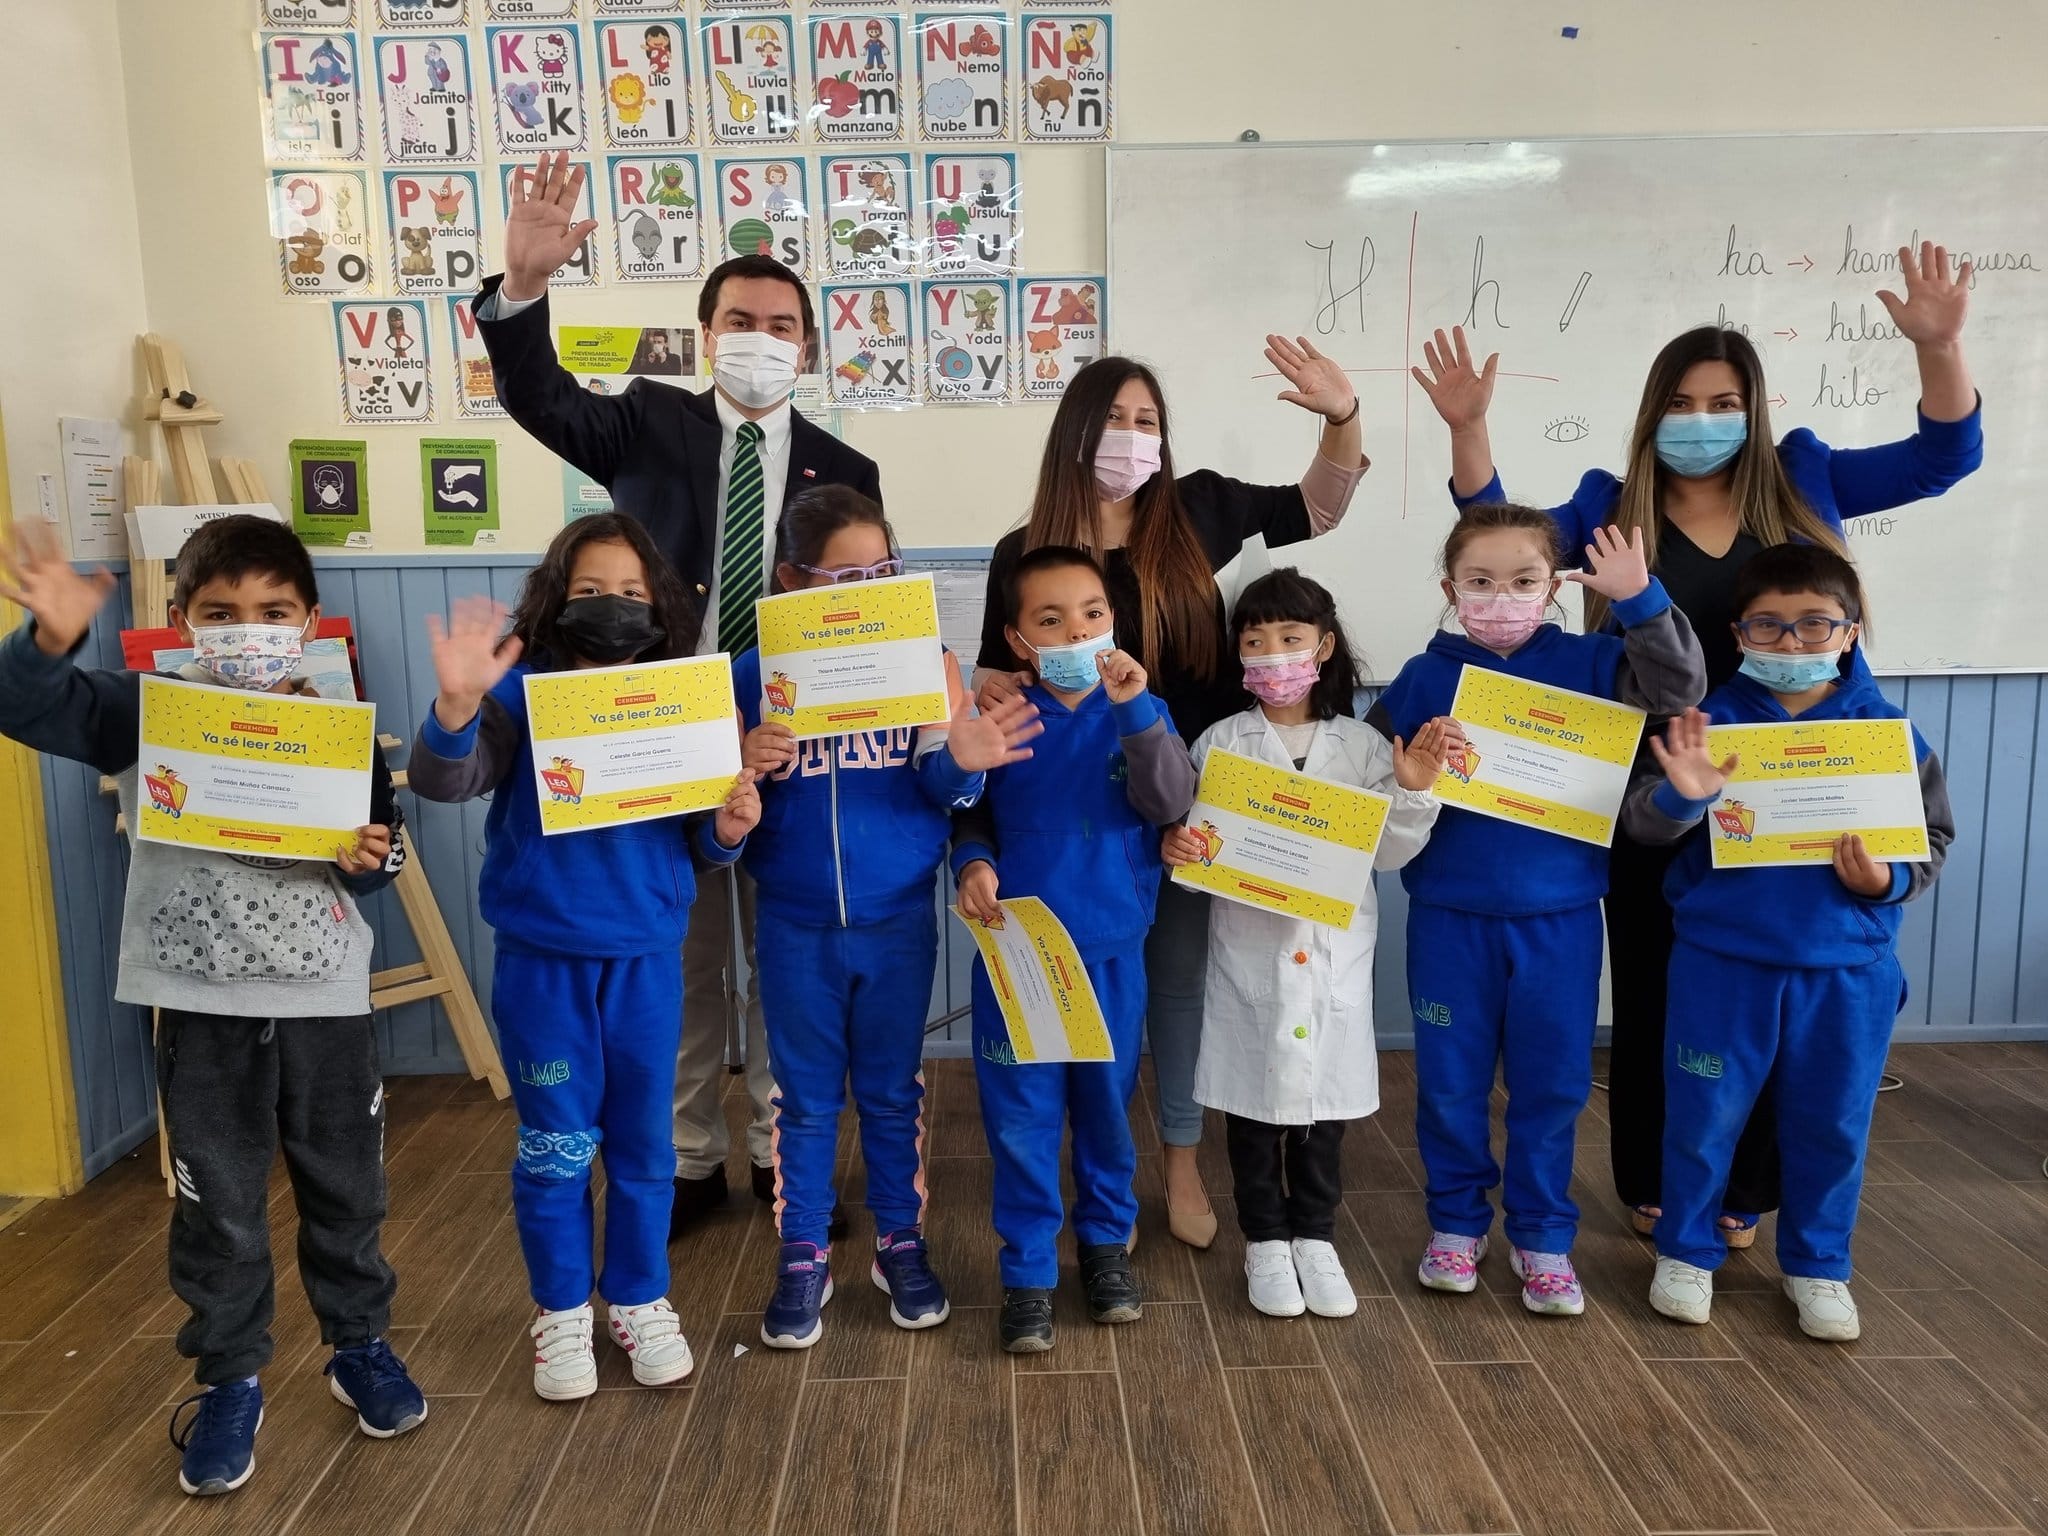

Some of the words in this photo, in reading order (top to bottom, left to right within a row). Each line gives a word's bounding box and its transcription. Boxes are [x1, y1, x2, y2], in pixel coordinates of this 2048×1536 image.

[273, 6, 317, 21] abeja
[390, 8, 433, 21] barco
[497, 2, 533, 13] casa
[607, 28, 628, 69] L
[817, 22, 857, 59] M
[926, 21, 957, 62] N
[1032, 21, 1061, 69] Ñ
[274, 39, 305, 82] I
[388, 44, 406, 83] J
[499, 34, 529, 75] K
[854, 69, 894, 83] Mario
[956, 60, 1001, 74] Nemo
[1066, 66, 1105, 82] Ñoño
[542, 80, 571, 97] Kitty
[648, 73, 671, 87] Lilo
[747, 74, 788, 88] Lluvia
[316, 90, 350, 106] Igor
[413, 91, 466, 105] Jaimito
[859, 86, 896, 116] m
[1078, 86, 1101, 128] ñ
[549, 98, 578, 136] k
[974, 96, 1000, 127] n
[330, 109, 343, 149] i
[445, 107, 458, 156] j
[617, 124, 649, 140] león
[722, 122, 756, 137] llave
[827, 120, 894, 134] manzana
[931, 119, 967, 133] nube
[1044, 119, 1062, 133] ñu
[288, 139, 313, 153] isla
[506, 130, 548, 144] koala
[399, 139, 437, 158] jirafa
[620, 166, 645, 205] R
[729, 168, 752, 206] S
[833, 164, 853, 202] T
[936, 165, 961, 203] U
[286, 177, 323, 217] O
[397, 180, 421, 218] P
[659, 206, 694, 221] René
[861, 210, 907, 222] Tarzan
[968, 203, 1009, 219] Úrsula
[332, 231, 362, 247] Olaf
[431, 225, 476, 239] Patricio
[672, 235, 687, 263] r
[782, 237, 800, 266] s
[977, 234, 1001, 262] u
[1717, 223, 1774, 276] ha
[628, 258, 665, 272] ratón
[836, 259, 886, 274] tortuga
[941, 260, 966, 270] uva
[1836, 224, 2042, 291] hambrguesa
[337, 253, 366, 283] o
[447, 249, 475, 288] p
[295, 275, 321, 287] oso
[405, 276, 444, 290] perro
[1306, 235, 1376, 335] H
[1462, 233, 1510, 330] h
[831, 293, 863, 331] X
[930, 288, 957, 326] Y
[1030, 286, 1053, 324] Z
[346, 311, 378, 349] V
[1064, 328, 1095, 340] Zeus
[858, 334, 906, 348] Xóchitl
[965, 333, 1002, 346] Yoda
[375, 356, 424, 371] Violeta
[881, 358, 908, 386] x
[977, 354, 1003, 391] y
[840, 386, 896, 400] xilófono
[936, 381, 972, 395] yoyo
[1031, 380, 1065, 390] zorro
[1812, 363, 1889, 409] hilo
[397, 381, 423, 408] v
[470, 397, 501, 409] waff
[355, 404, 393, 415] vaca
[824, 613, 859, 623] CEREMONIA
[801, 630, 816, 640] Ya
[818, 627, 831, 639] sé
[834, 625, 855, 637] leer
[859, 621, 886, 634] 2021
[617, 695, 655, 705] CEREMONIA
[769, 690, 784, 701] LEO
[590, 713, 606, 724] Ya
[610, 709, 624, 722] sé
[628, 708, 651, 721] leer
[655, 703, 683, 716] 2021
[233, 723, 276, 735] CEREMONIA
[1503, 714, 1516, 727] Ya
[1519, 718, 1532, 730] sé
[1534, 723, 1556, 738] leer
[1557, 729, 1585, 744] 2021
[201, 731, 218, 745] Ya
[222, 735, 239, 747] sé
[242, 737, 270, 750] leer
[273, 740, 308, 754] 2021
[1759, 761, 1777, 770] Ya
[1779, 759, 1794, 769] sé
[1797, 758, 1821, 769] leer
[1825, 756, 1855, 767] 2021
[150, 783, 170, 800] LEO
[547, 776, 569, 789] LEO
[1274, 793, 1309, 809] CEREMONIA
[1247, 797, 1260, 811] Ya
[1263, 803, 1276, 815] sé
[1279, 807, 1300, 822] leer
[1302, 814, 1329, 830] 2021
[1719, 817, 1740, 828] LEO
[1036, 935, 1046, 949] Ya
[1043, 950, 1052, 963] sé
[1049, 965, 1061, 986] leer
[1057, 989, 1072, 1013] 2021
[1414, 997, 1452, 1028] LMB
[1676, 1043, 1724, 1079] LMB
[519, 1059, 570, 1087] LMB
